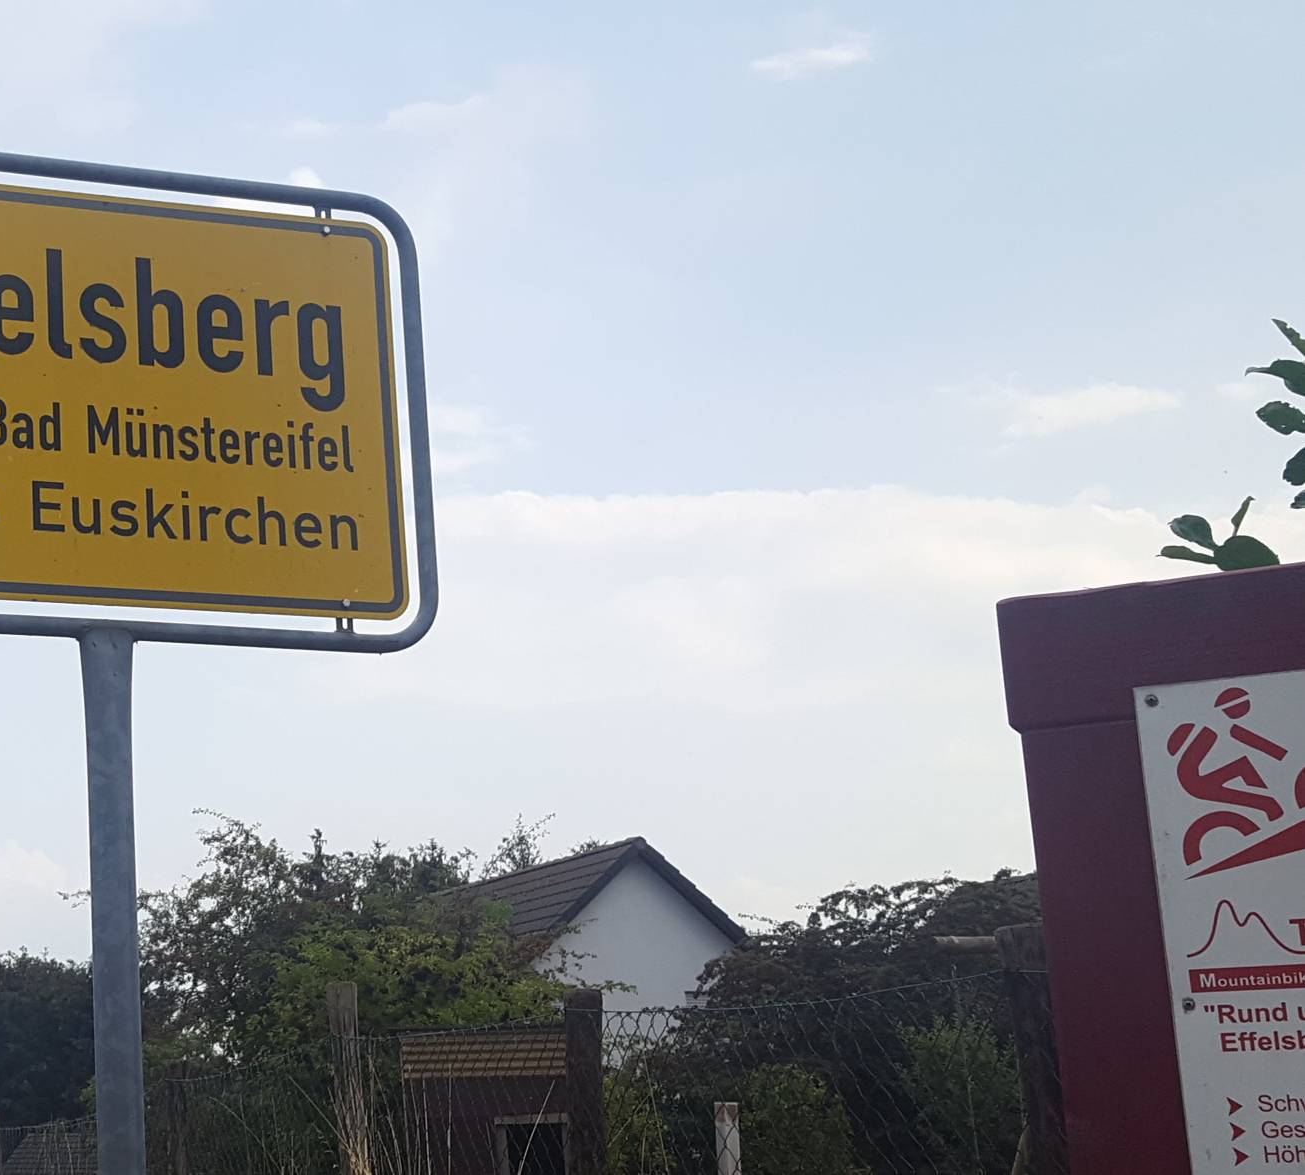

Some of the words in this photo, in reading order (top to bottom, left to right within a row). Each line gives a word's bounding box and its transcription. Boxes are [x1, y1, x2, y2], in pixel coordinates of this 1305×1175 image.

[86, 404, 355, 473] Münstereifel
[31, 480, 359, 551] Euskirchen
[1203, 1002, 1288, 1024] "Rund
